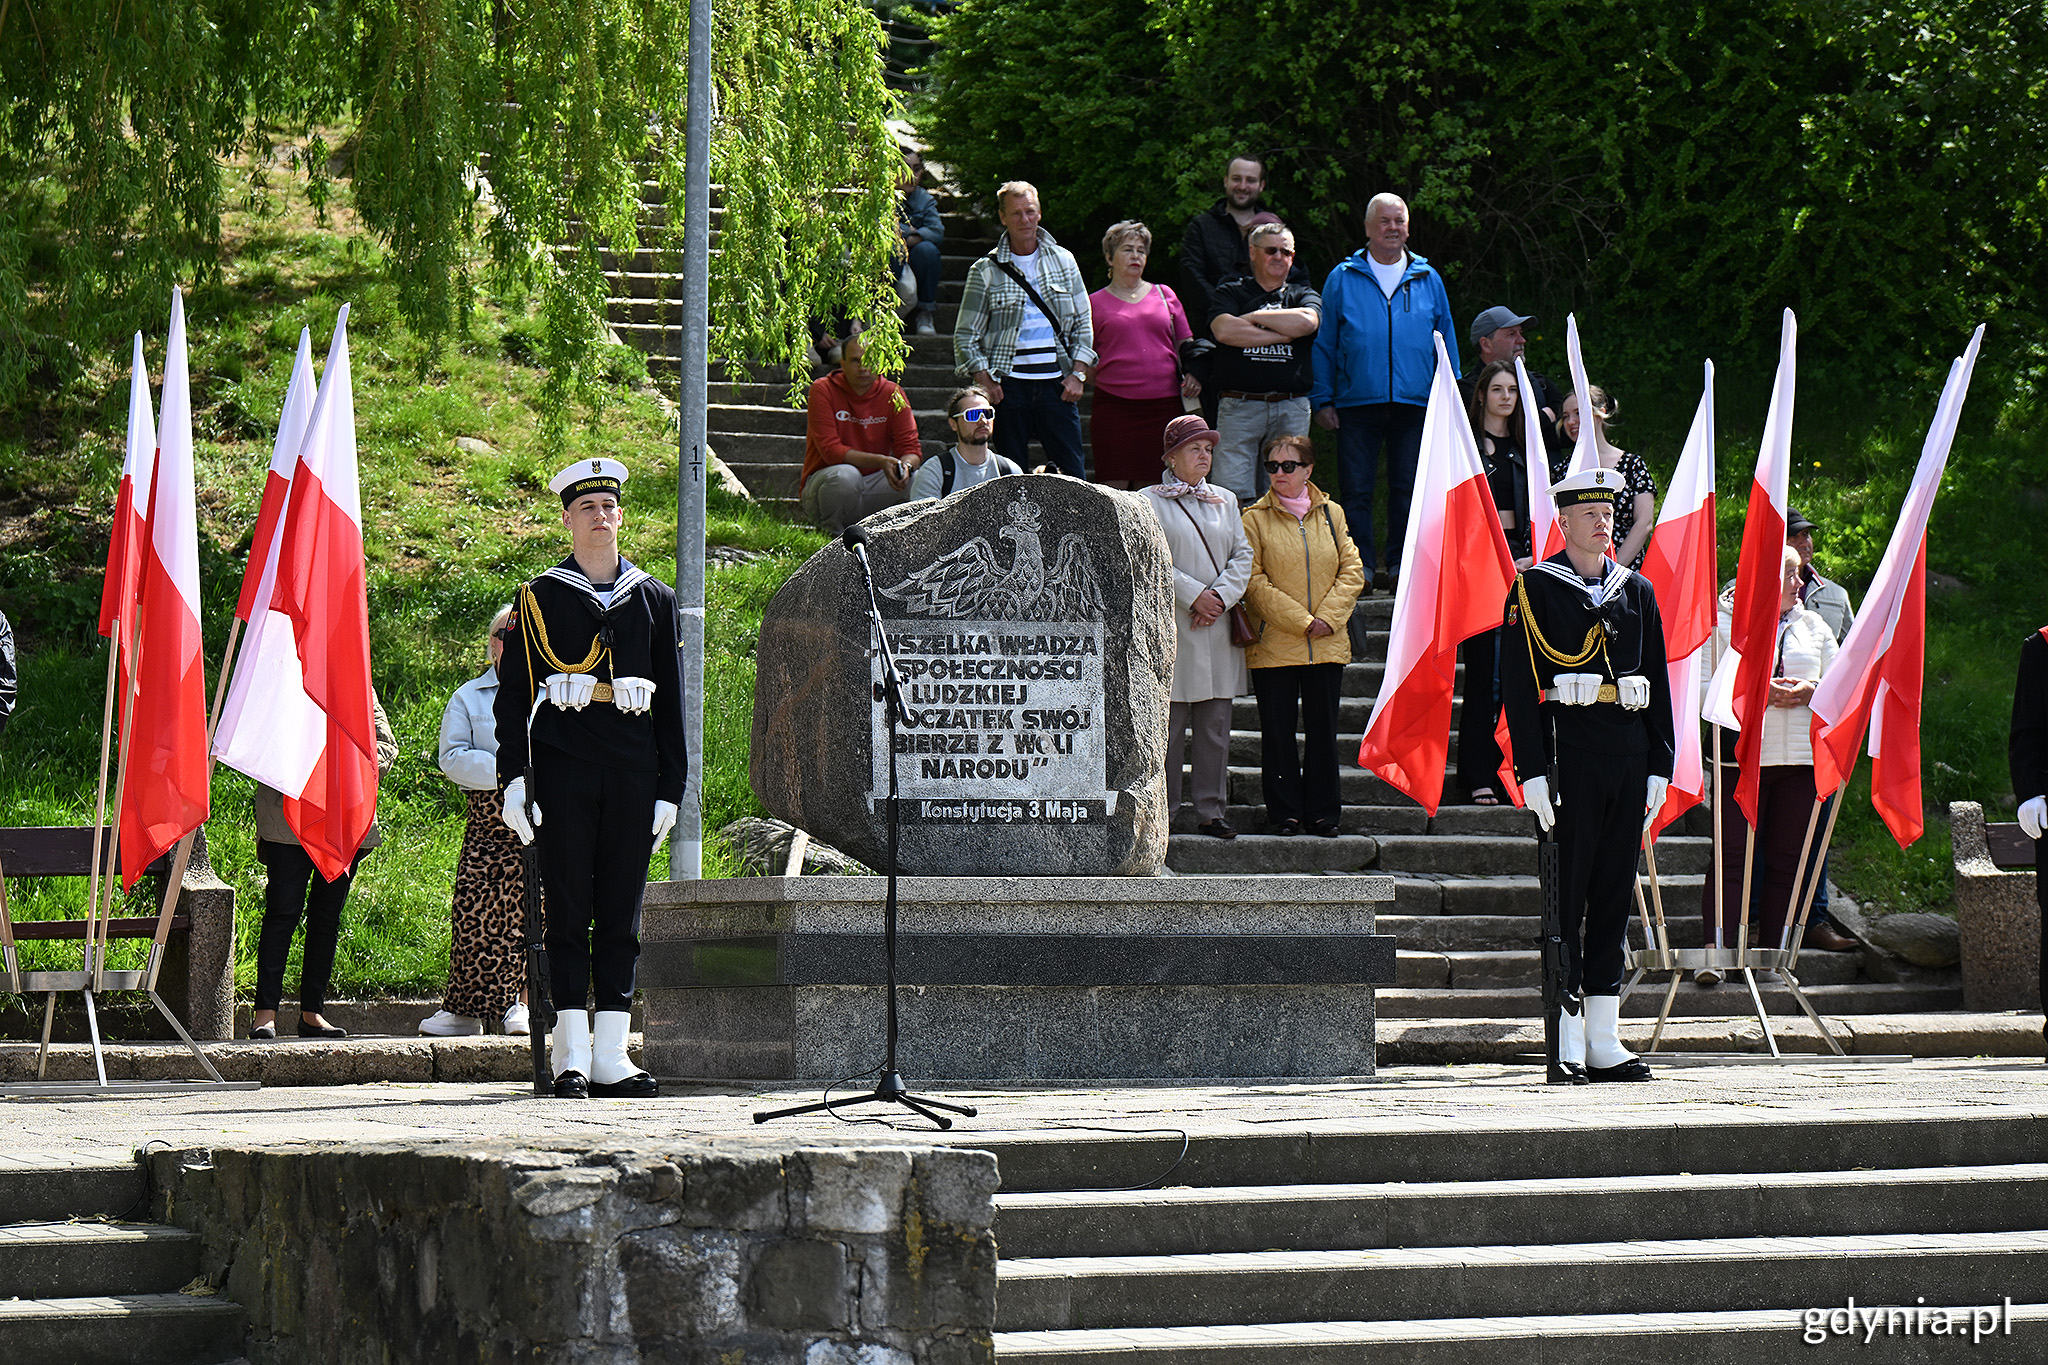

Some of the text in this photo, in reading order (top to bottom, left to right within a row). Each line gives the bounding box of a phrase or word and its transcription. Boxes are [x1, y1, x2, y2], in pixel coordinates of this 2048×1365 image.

[692, 445, 698, 461] 1
[692, 466, 698, 482] 1
[998, 635, 1098, 655] WŁADZA
[893, 656, 1083, 680] SPOŁECZNOŚCI
[912, 684, 1028, 705] LUDZKIEJ
[1022, 704, 1091, 730] SWÓJ
[895, 733, 979, 754] BIERZE
[987, 734, 1004, 754] Z
[921, 801, 1088, 823] Konstytucja 3 Maja
